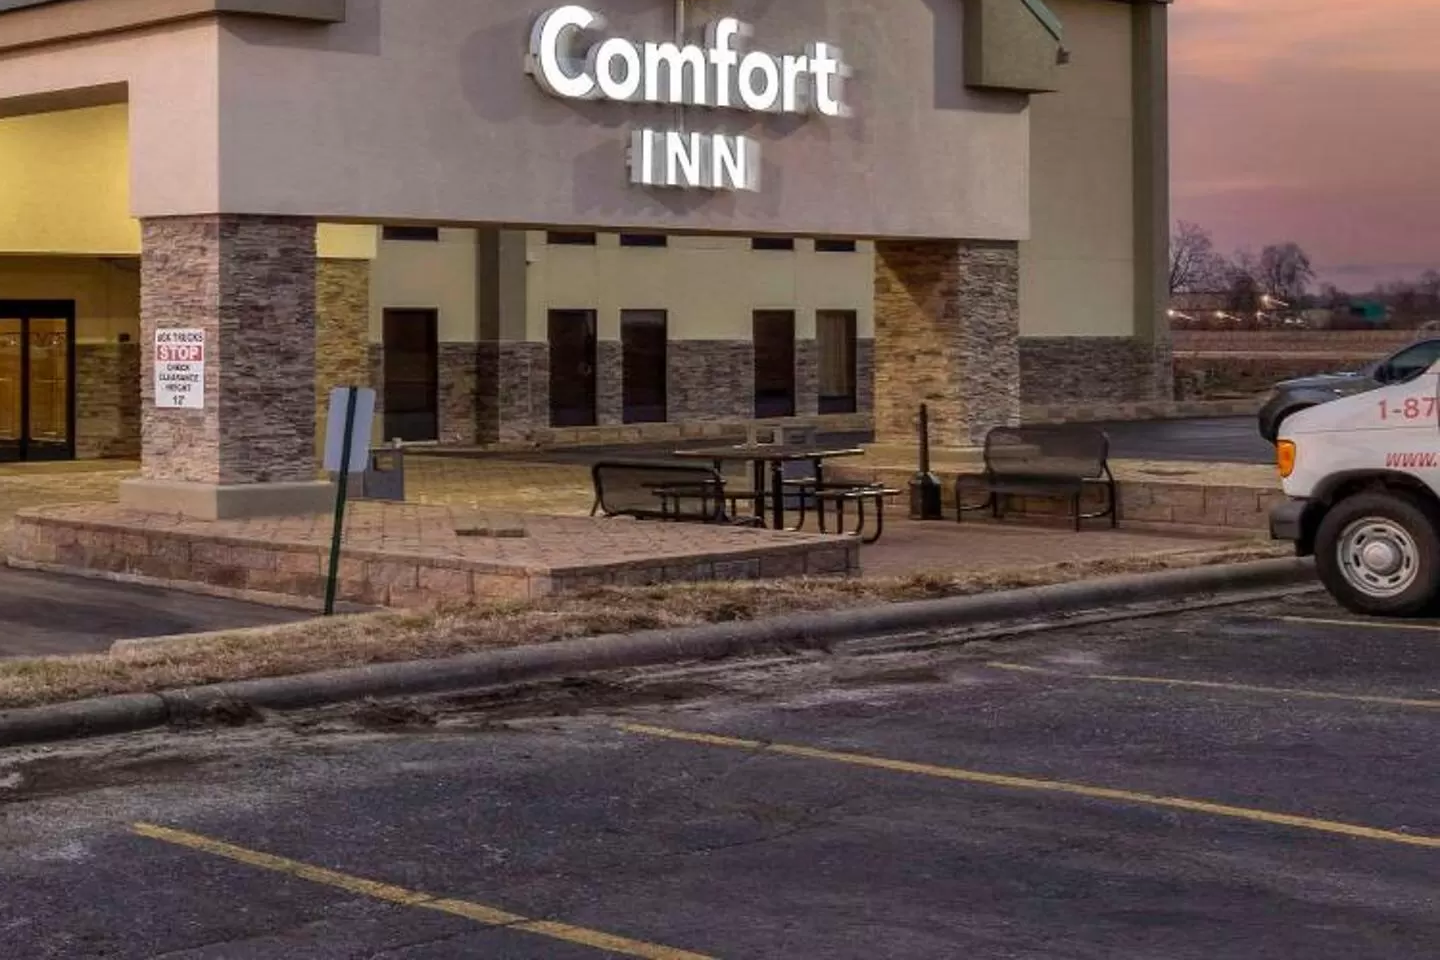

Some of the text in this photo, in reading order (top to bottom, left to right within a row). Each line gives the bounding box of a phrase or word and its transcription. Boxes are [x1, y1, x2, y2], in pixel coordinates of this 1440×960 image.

[539, 5, 842, 116] Comfort
[640, 129, 748, 190] INN
[160, 345, 199, 360] STOP
